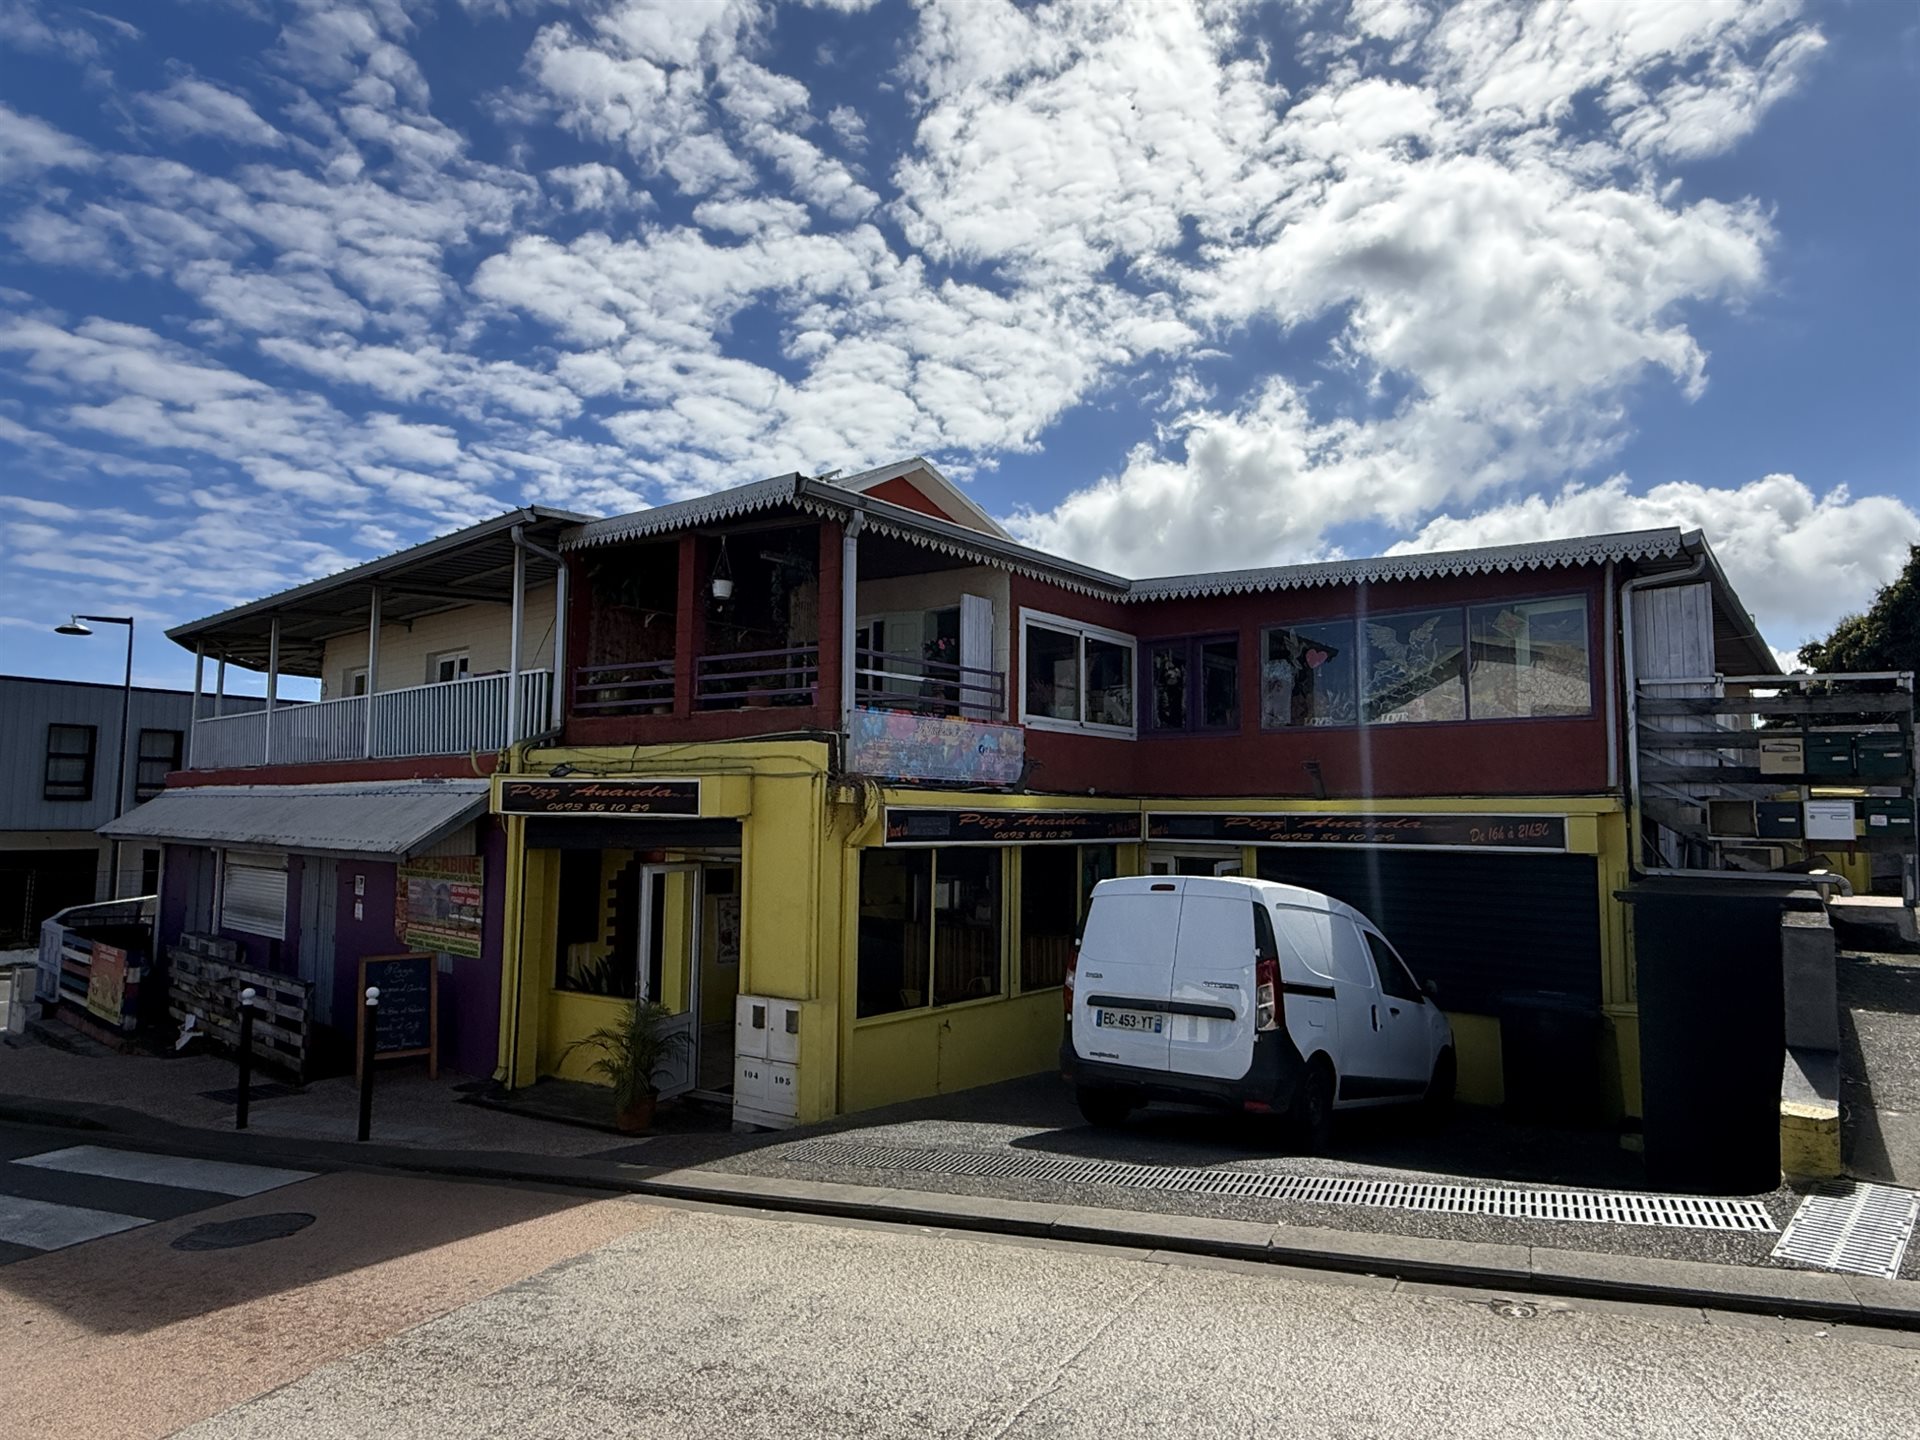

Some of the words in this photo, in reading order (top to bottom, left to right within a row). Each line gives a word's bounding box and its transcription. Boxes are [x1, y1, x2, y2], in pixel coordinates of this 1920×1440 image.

[1303, 716, 1333, 727] LOVE
[1380, 712, 1409, 722] LOVE
[509, 784, 561, 800] Pizz
[545, 802, 582, 811] 0693
[587, 802, 605, 812] 86
[609, 803, 626, 812] 10
[630, 803, 651, 812] 29
[958, 812, 1009, 829] Pizz
[1223, 816, 1285, 831] Pizz
[993, 830, 1025, 840] 0693
[1029, 830, 1044, 840] 86
[1045, 830, 1058, 839] 10
[1060, 829, 1073, 839] 29
[1269, 832, 1314, 841] 0693
[1319, 833, 1341, 842] 86
[1347, 833, 1367, 841] 10
[1372, 833, 1396, 842] 29
[1469, 827, 1485, 842] De
[1488, 825, 1505, 840] 16h
[1507, 825, 1515, 839] à
[399, 858, 430, 871] HEZ
[433, 857, 480, 875] SABINE
[744, 1070, 759, 1080] 104
[775, 1076, 791, 1086] 105
